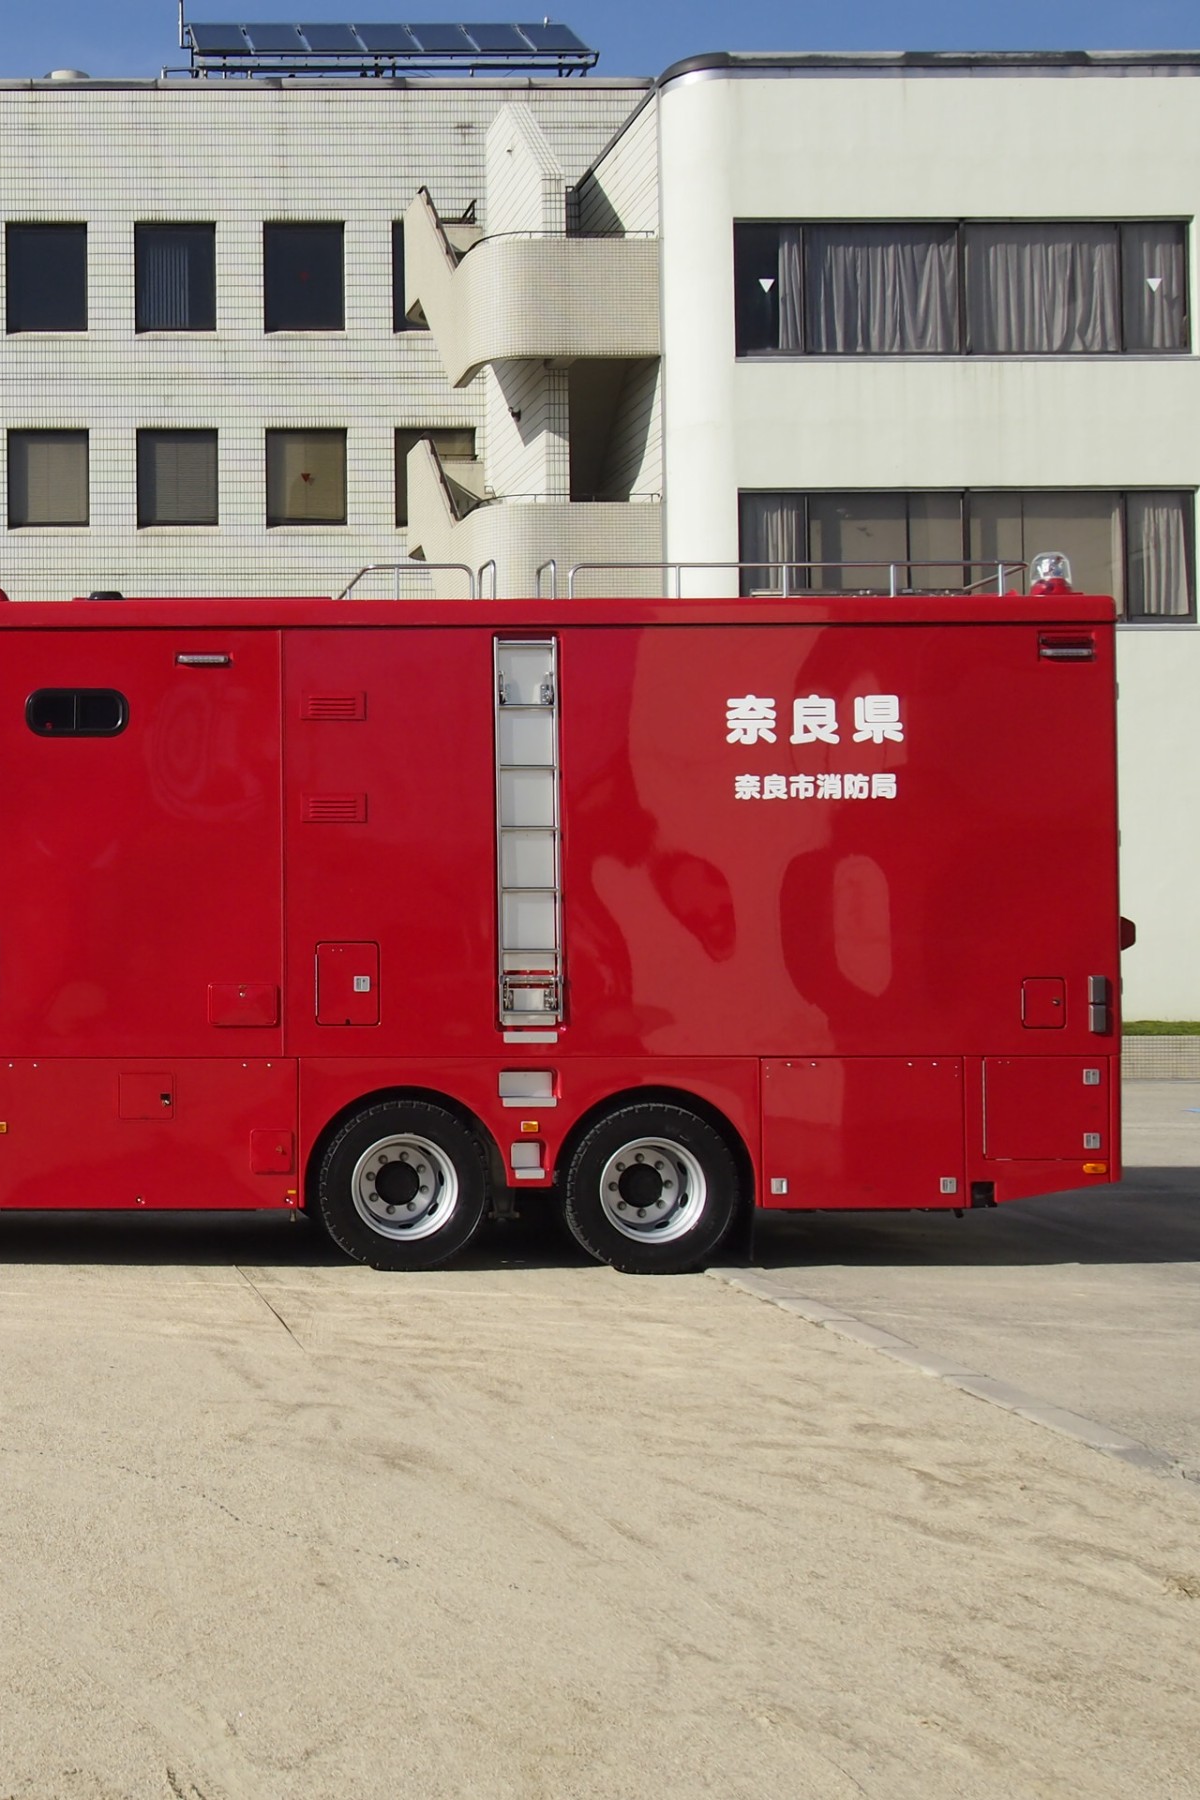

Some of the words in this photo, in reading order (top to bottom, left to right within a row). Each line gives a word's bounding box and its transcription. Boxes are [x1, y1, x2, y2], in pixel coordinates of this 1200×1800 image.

[725, 694, 904, 745] 奈良県
[734, 773, 898, 800] 奈良市消防局
